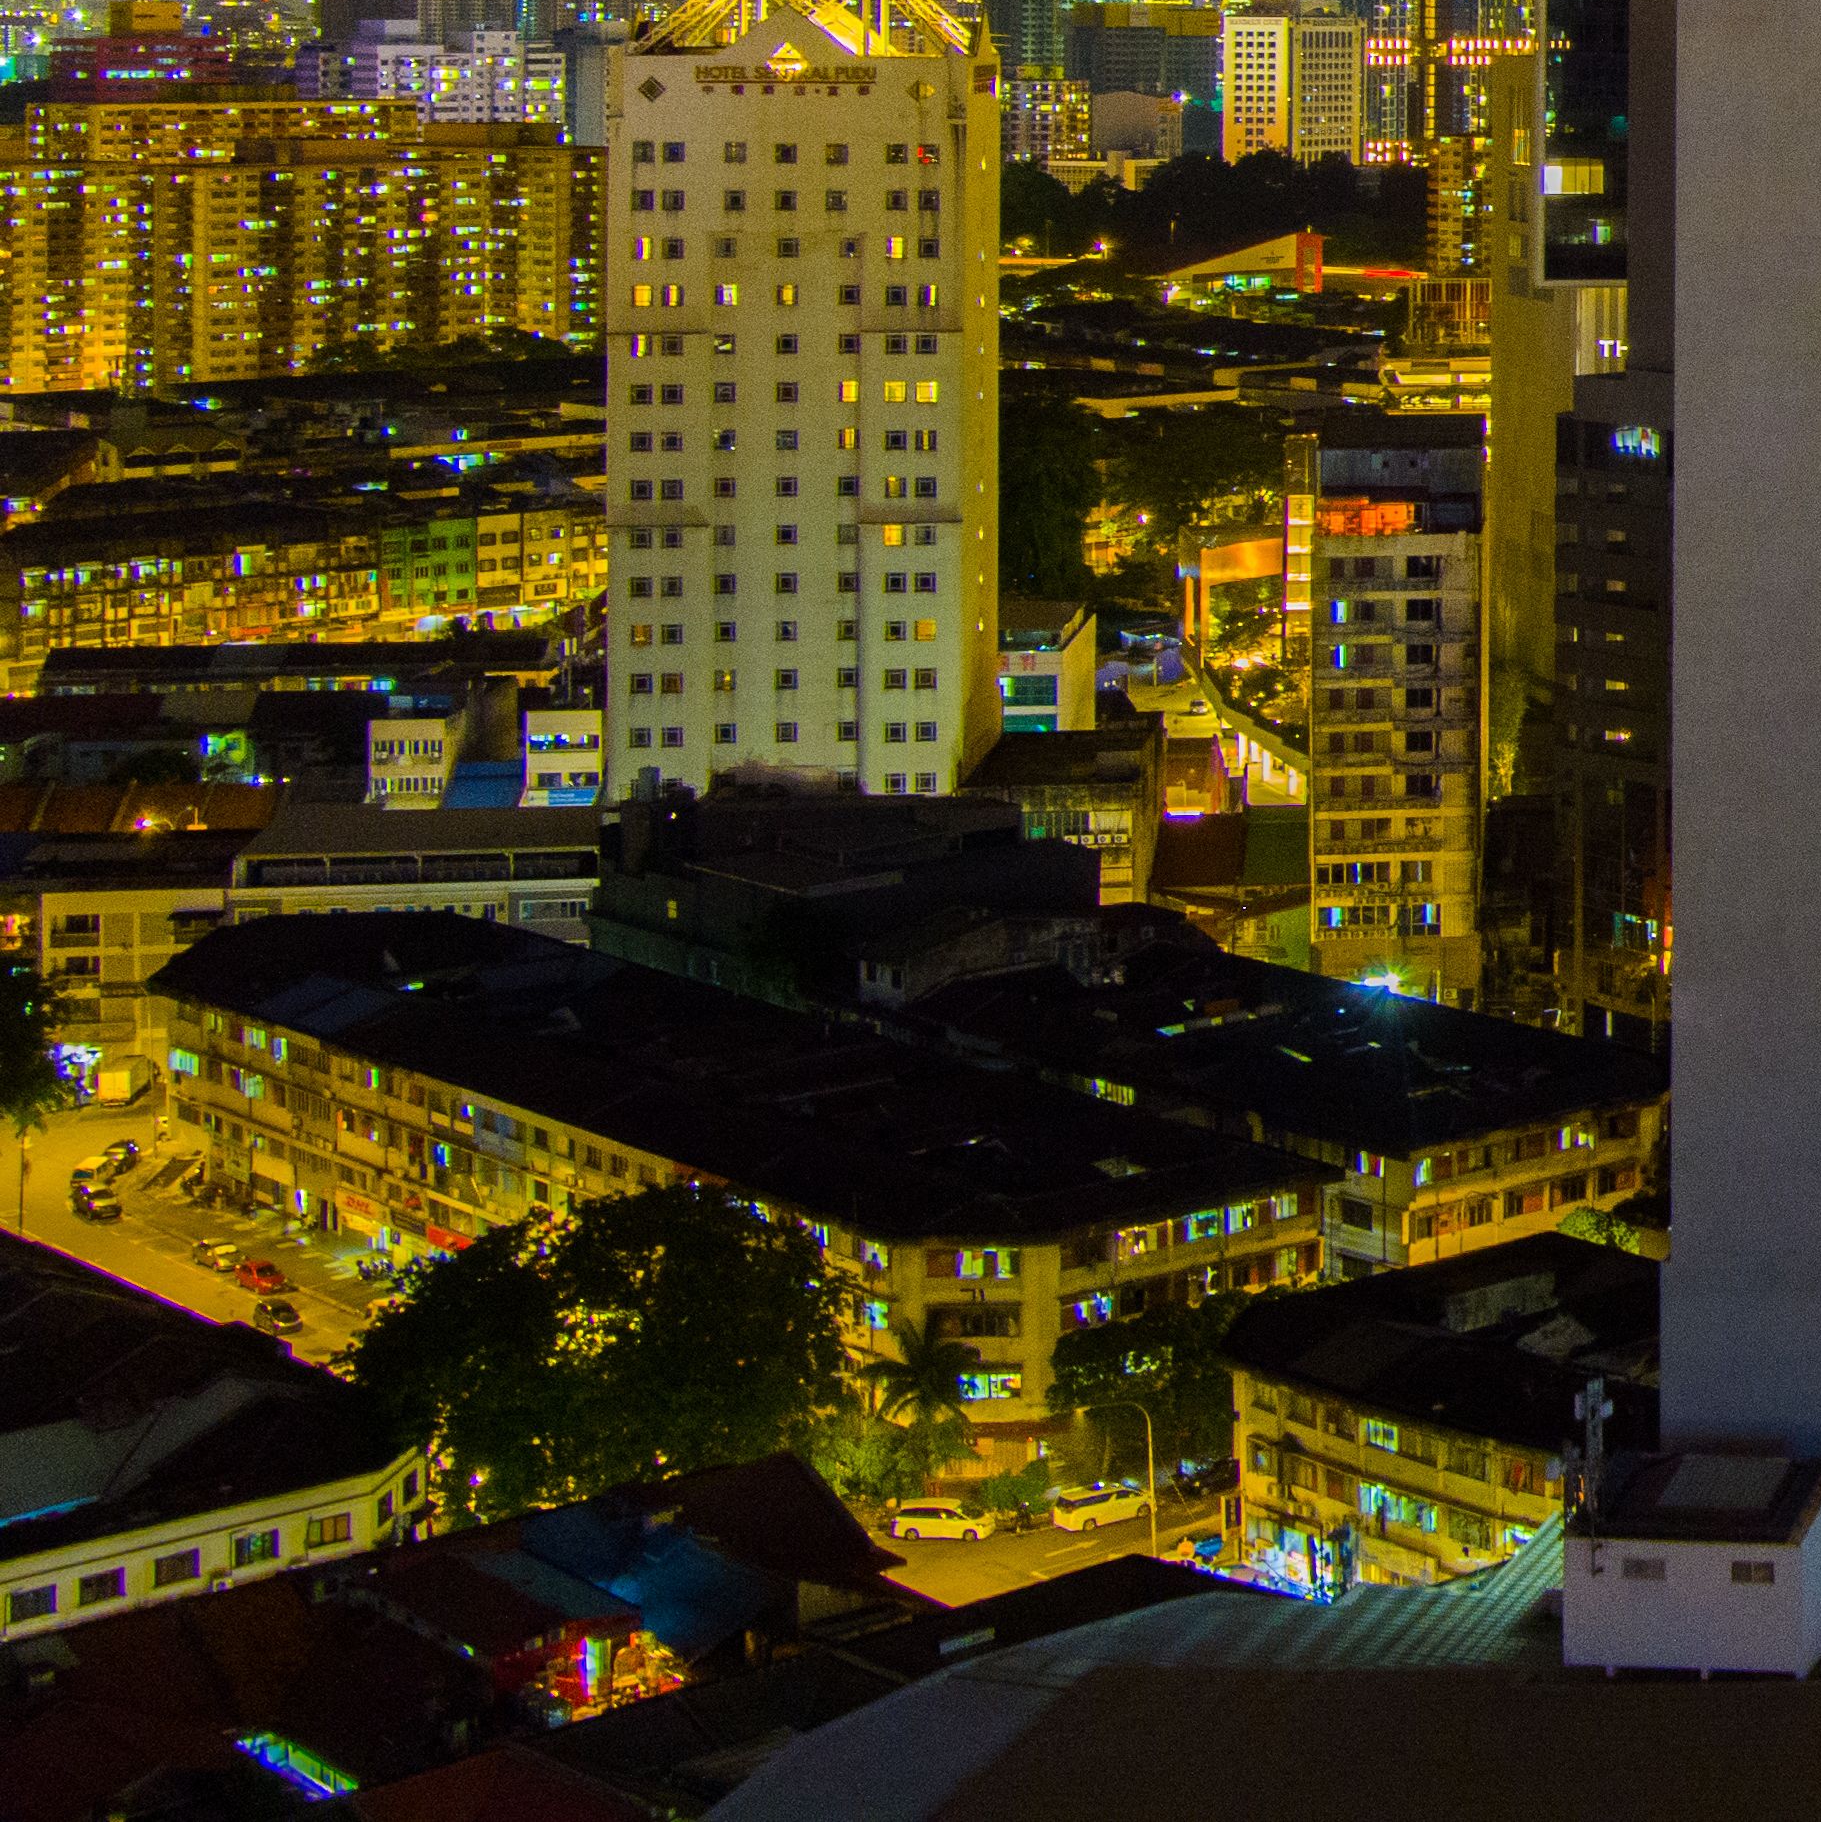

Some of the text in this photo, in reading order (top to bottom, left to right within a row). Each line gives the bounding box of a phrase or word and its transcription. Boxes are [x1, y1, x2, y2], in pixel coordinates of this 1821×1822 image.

[695, 66, 878, 80] HOTEL SERAL PUDU
